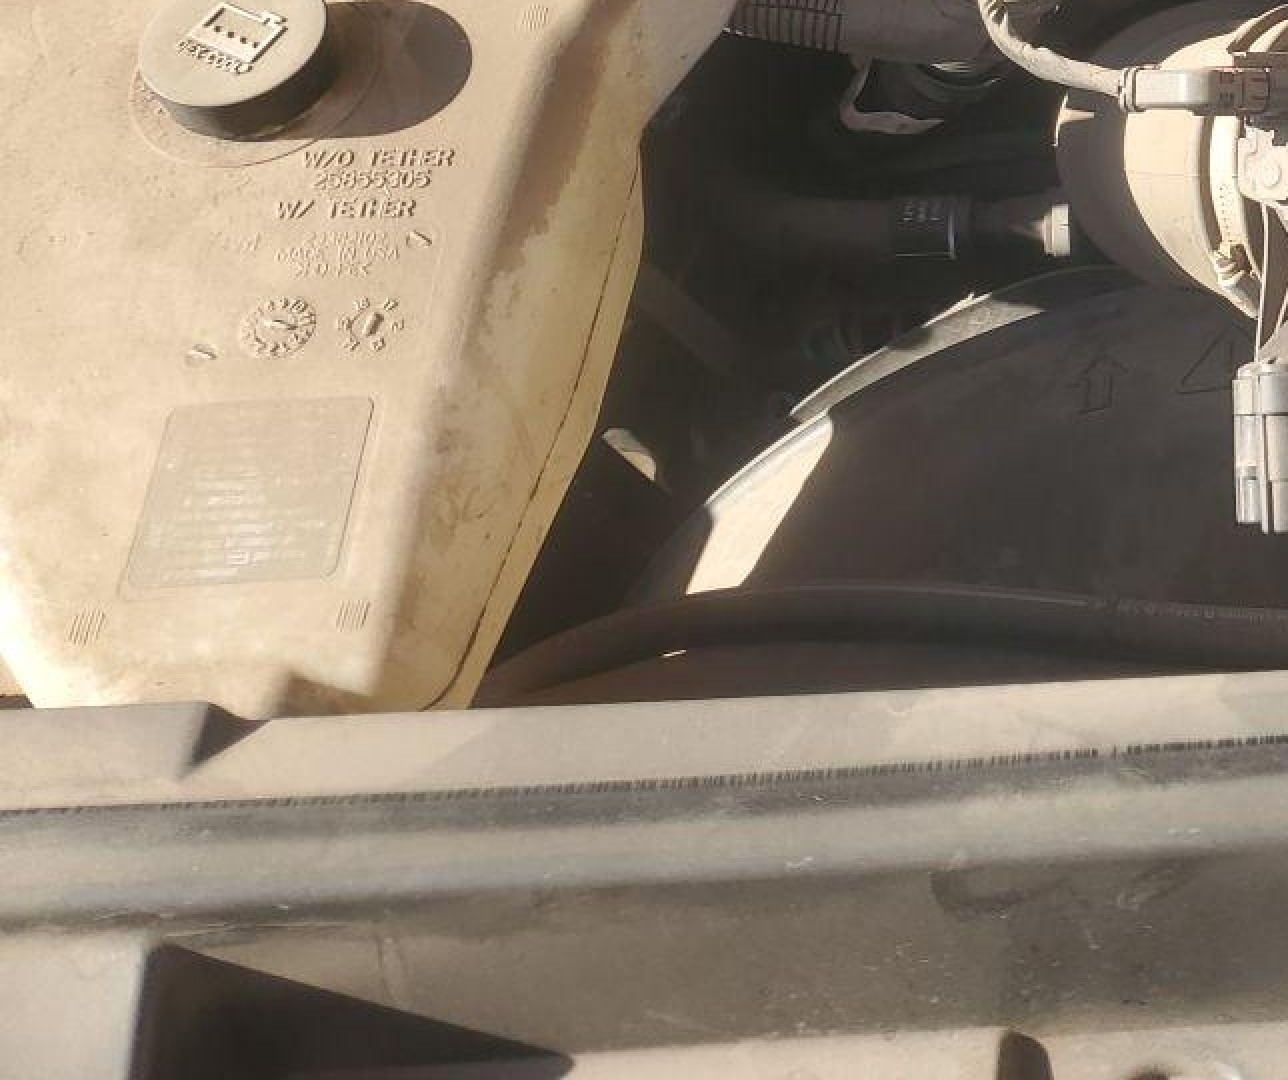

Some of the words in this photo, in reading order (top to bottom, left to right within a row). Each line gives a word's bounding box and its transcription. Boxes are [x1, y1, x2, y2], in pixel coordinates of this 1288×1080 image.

[303, 150, 355, 169] W/O
[371, 149, 456, 168] TETHER
[276, 199, 315, 219] W/
[331, 199, 418, 219] TETHER
